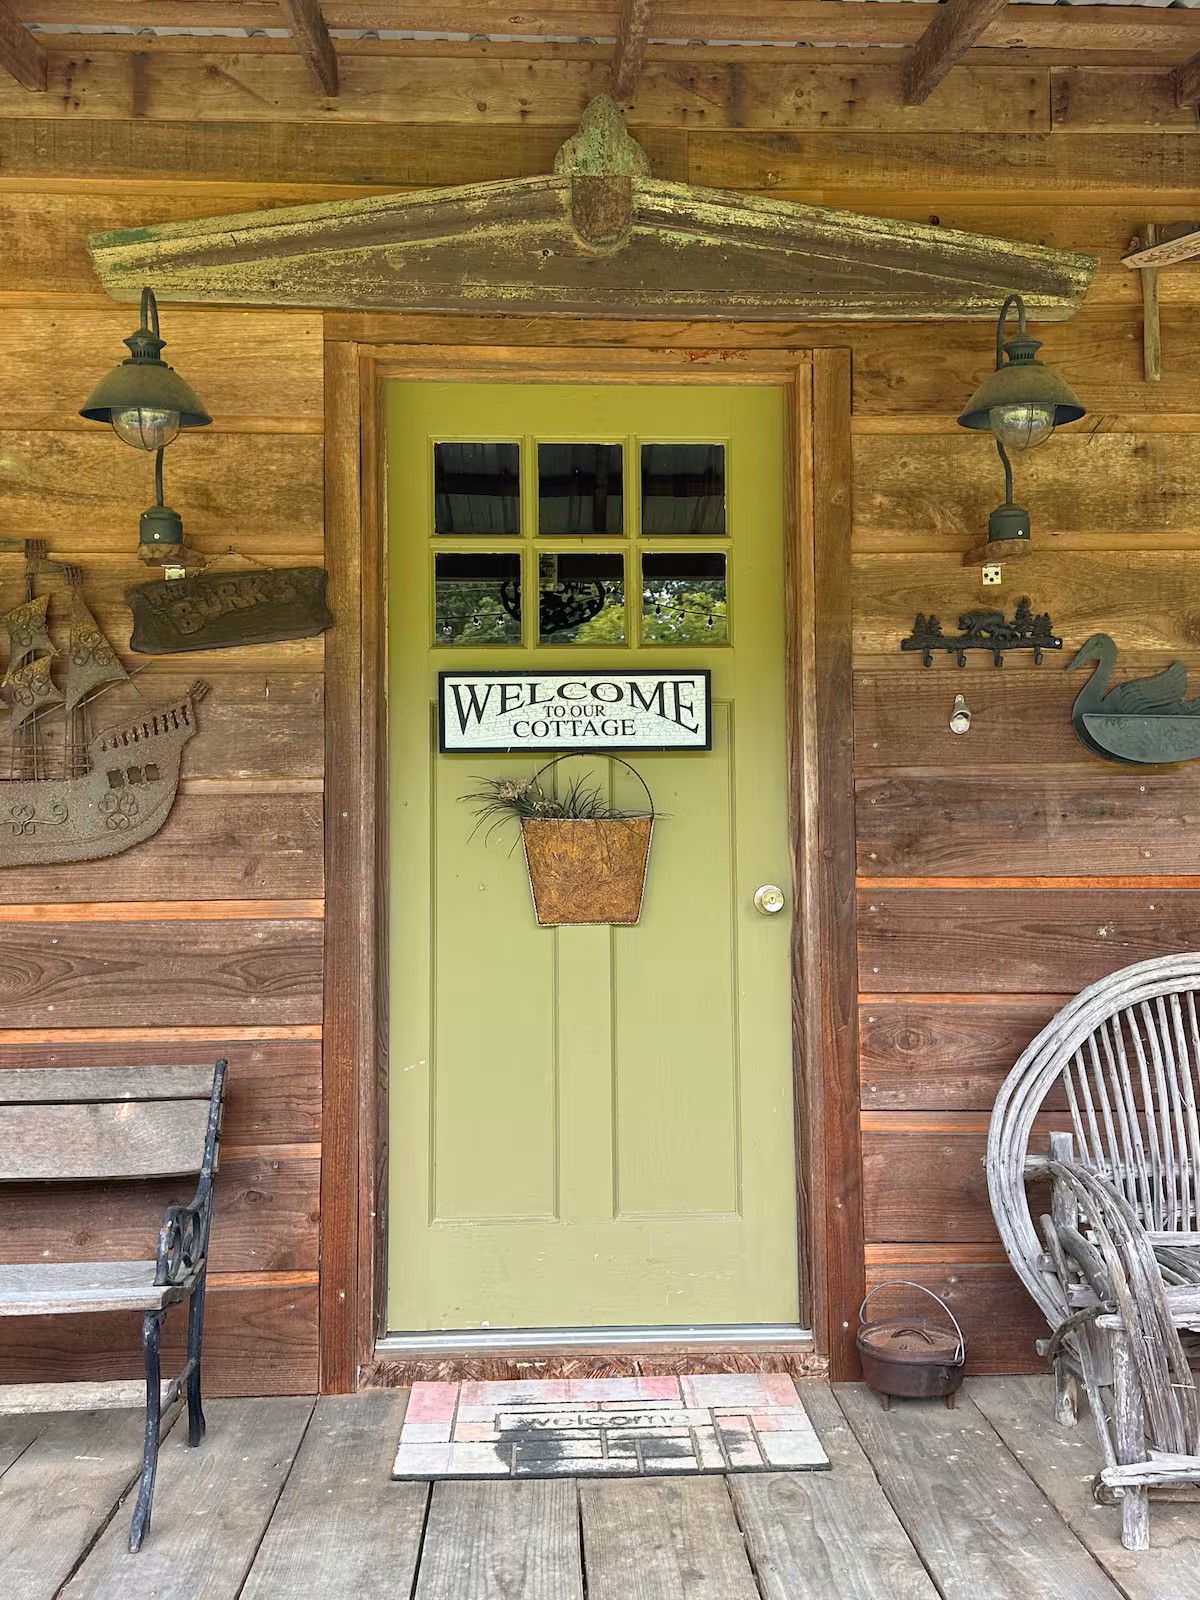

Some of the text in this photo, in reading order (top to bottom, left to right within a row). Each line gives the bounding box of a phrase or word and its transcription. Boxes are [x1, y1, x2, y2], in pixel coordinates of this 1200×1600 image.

[449, 680, 699, 736] WELCOME
[542, 704, 606, 718] TO OUR
[513, 719, 637, 738] COTTAGE
[521, 1414, 691, 1427] welcome
